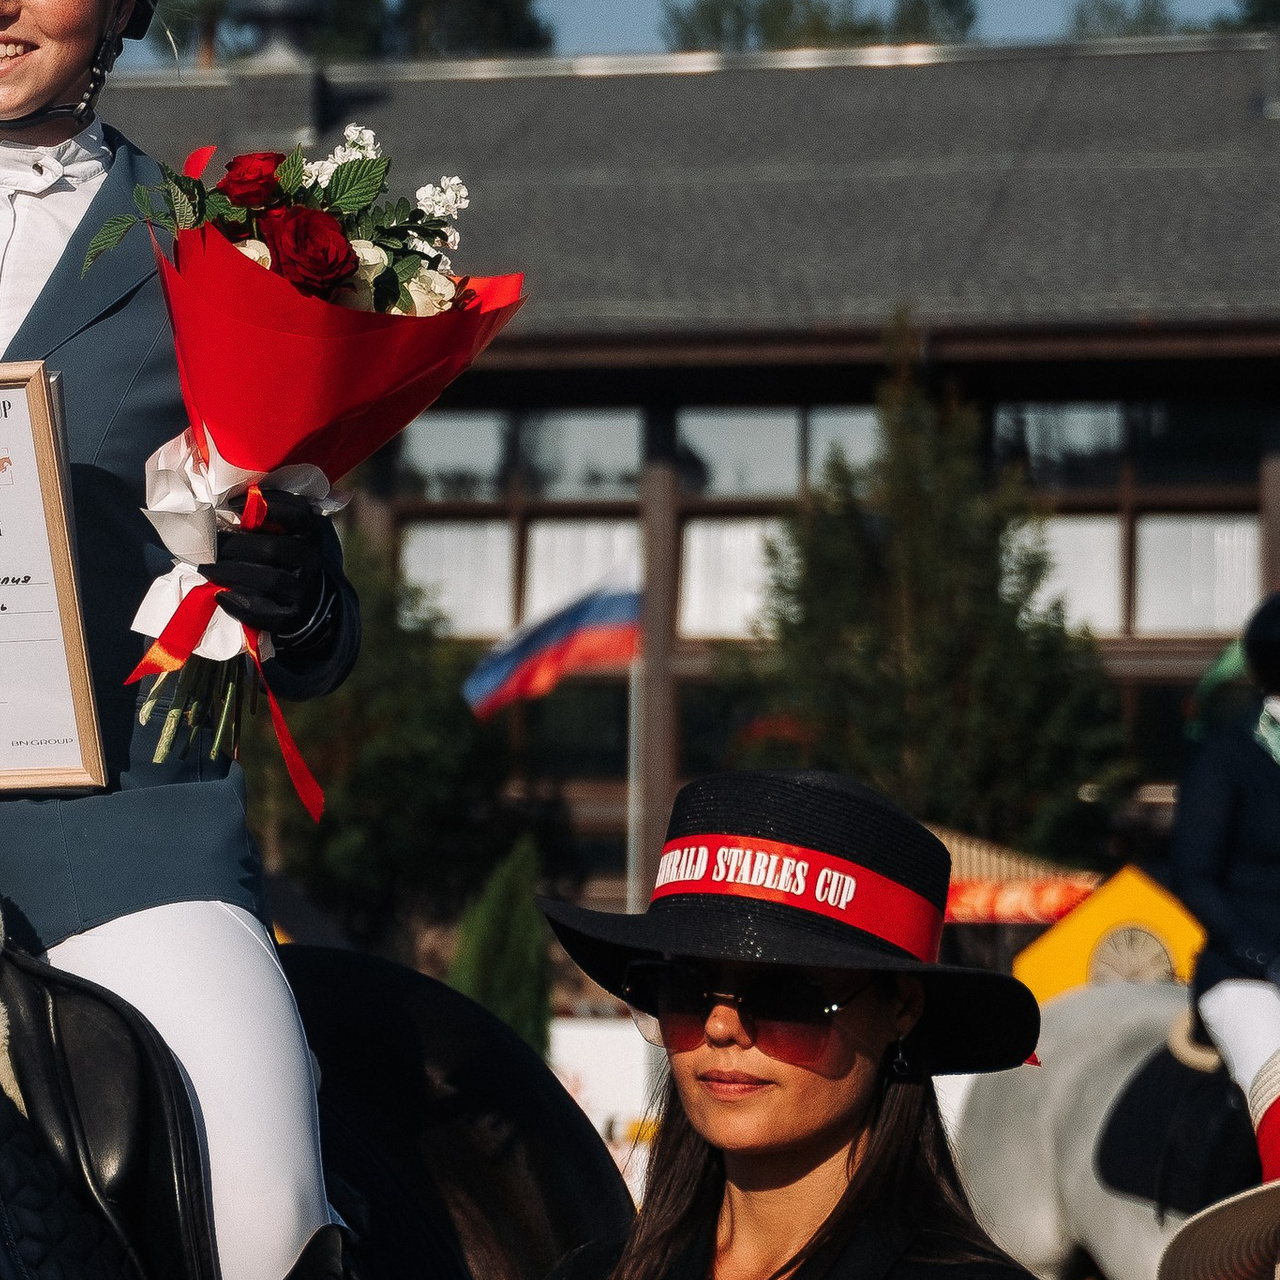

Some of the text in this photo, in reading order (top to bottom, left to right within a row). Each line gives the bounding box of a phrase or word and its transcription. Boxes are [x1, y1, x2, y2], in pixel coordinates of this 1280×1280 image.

[30, 738, 73, 746] GROUP
[655, 845, 857, 910] MERALD STABLES CUP
